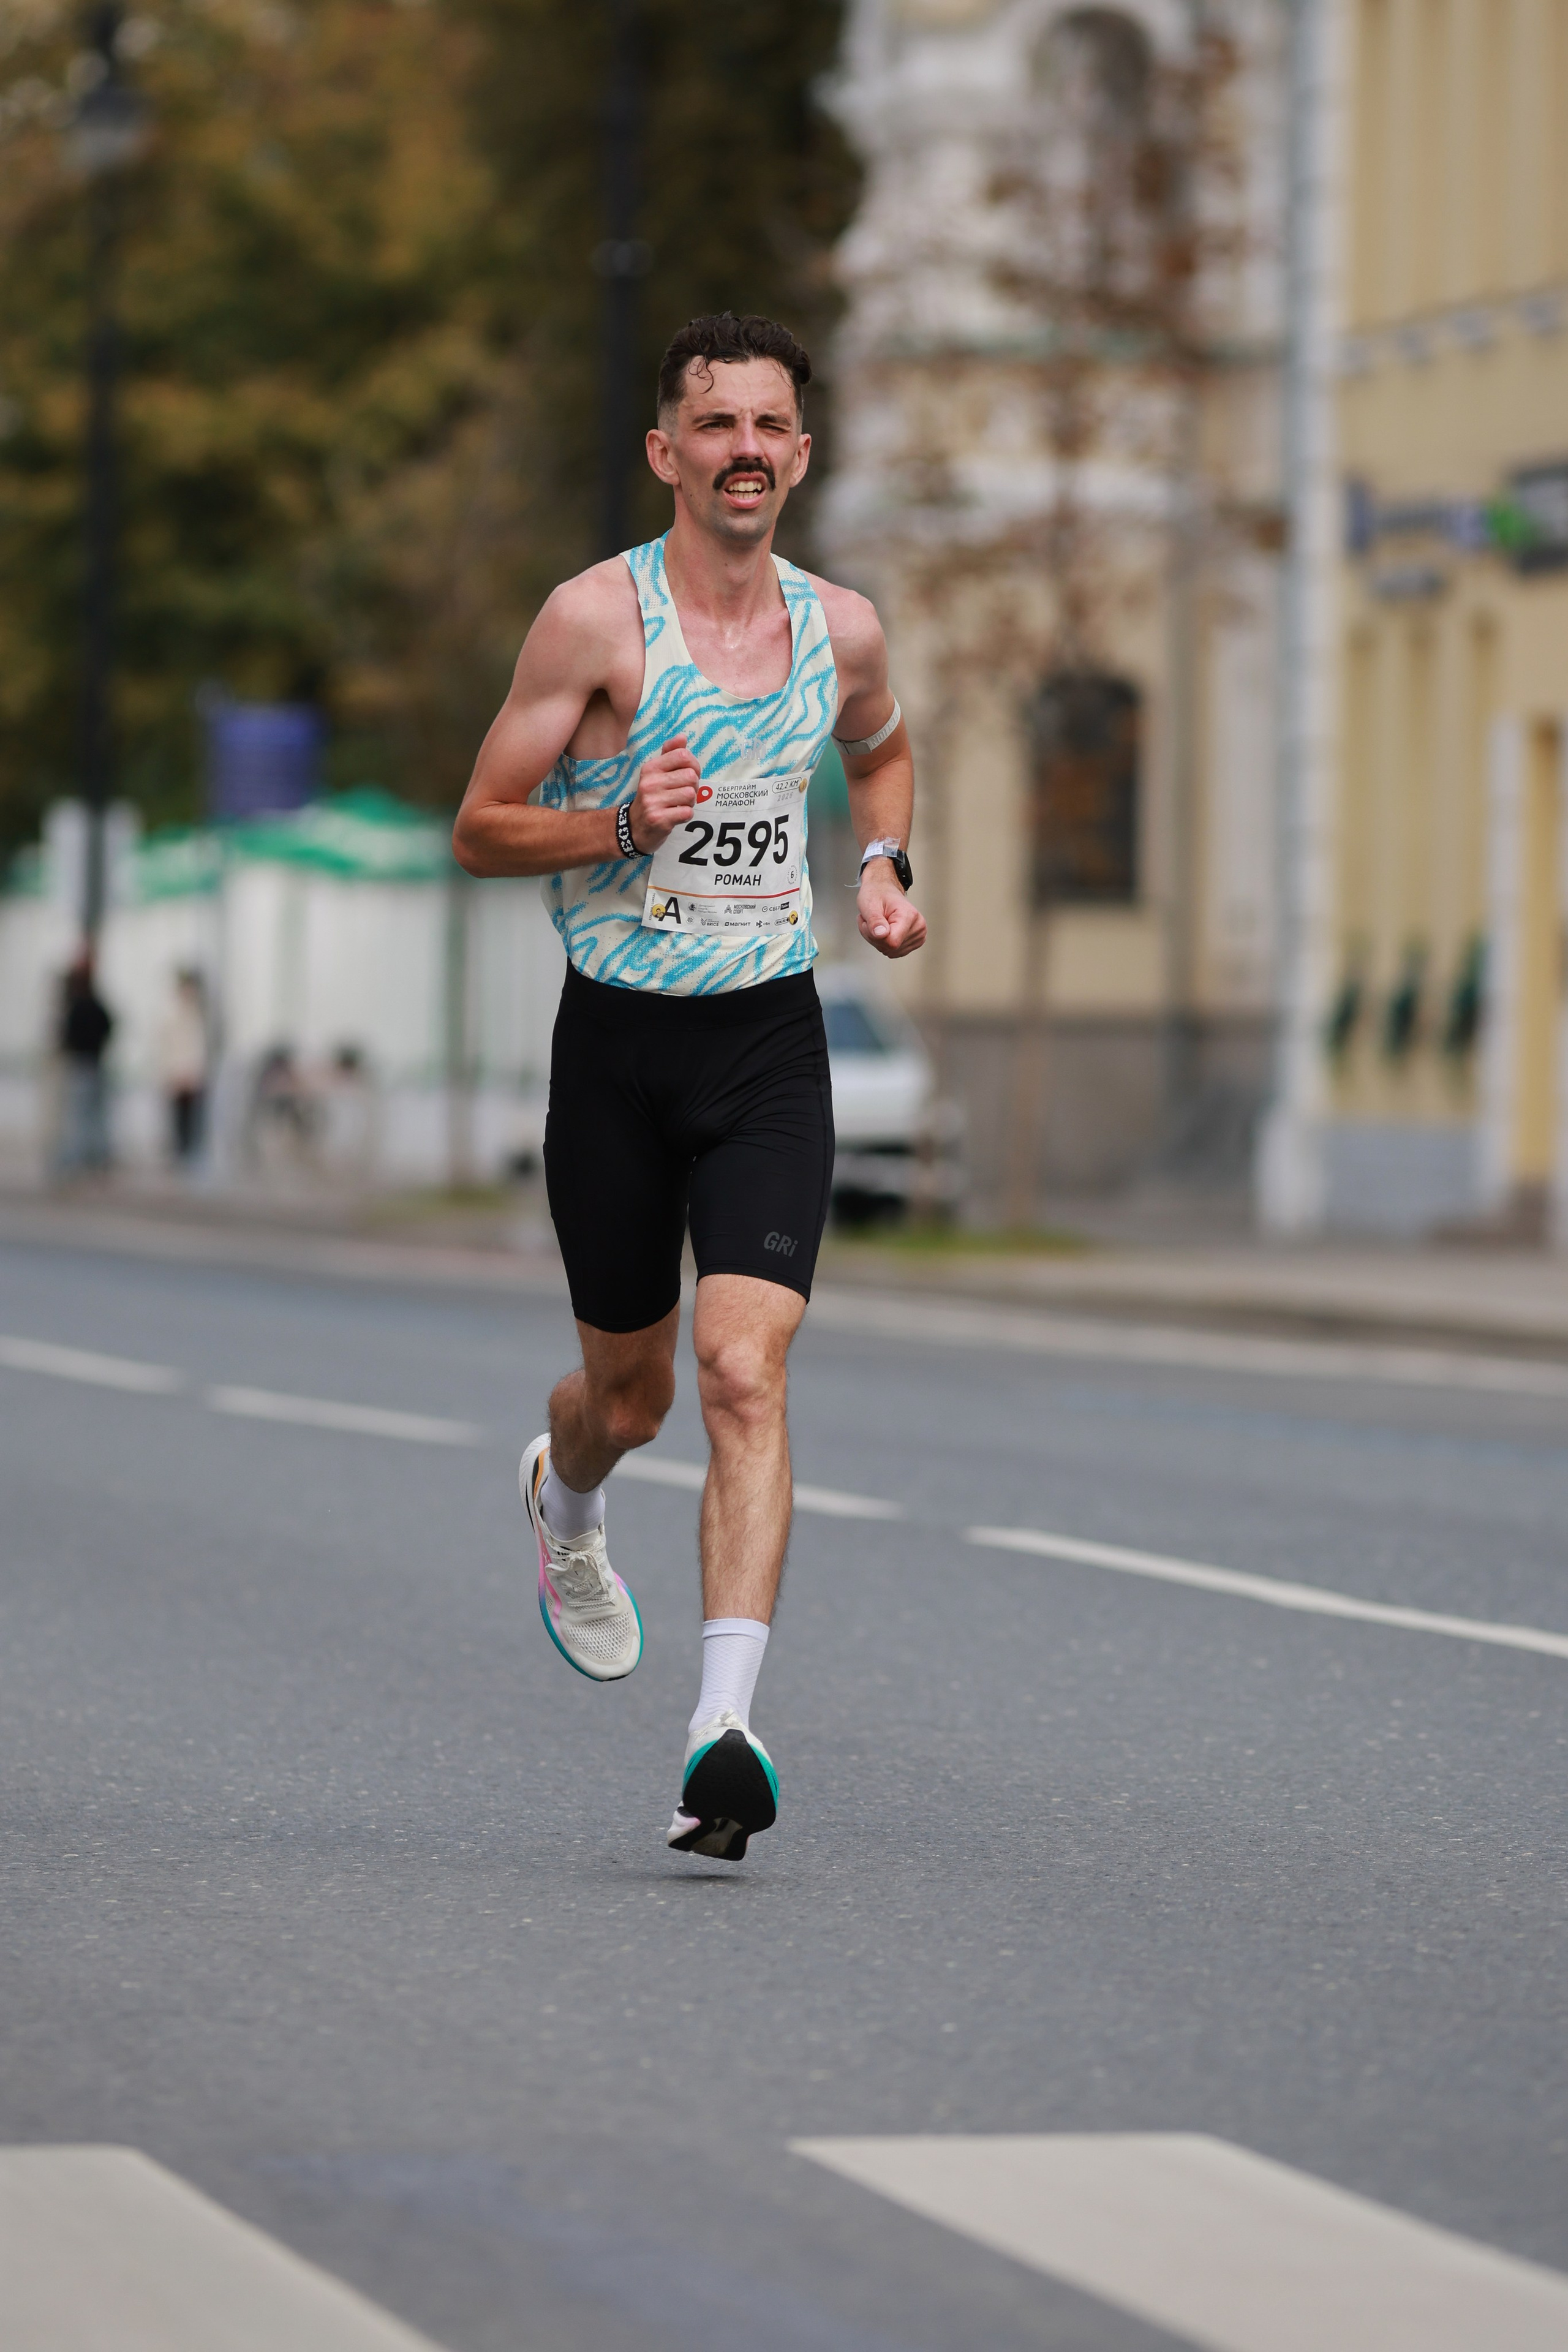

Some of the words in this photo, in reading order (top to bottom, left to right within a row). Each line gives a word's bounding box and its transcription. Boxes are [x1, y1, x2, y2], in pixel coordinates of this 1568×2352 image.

[717, 789, 768, 799] МОСКОВСКИЙ
[775, 782, 788, 791] 42,2
[678, 814, 789, 867] 2595
[714, 874, 761, 886] РОМАН
[658, 897, 681, 924] A
[763, 1231, 799, 1257] GRi
